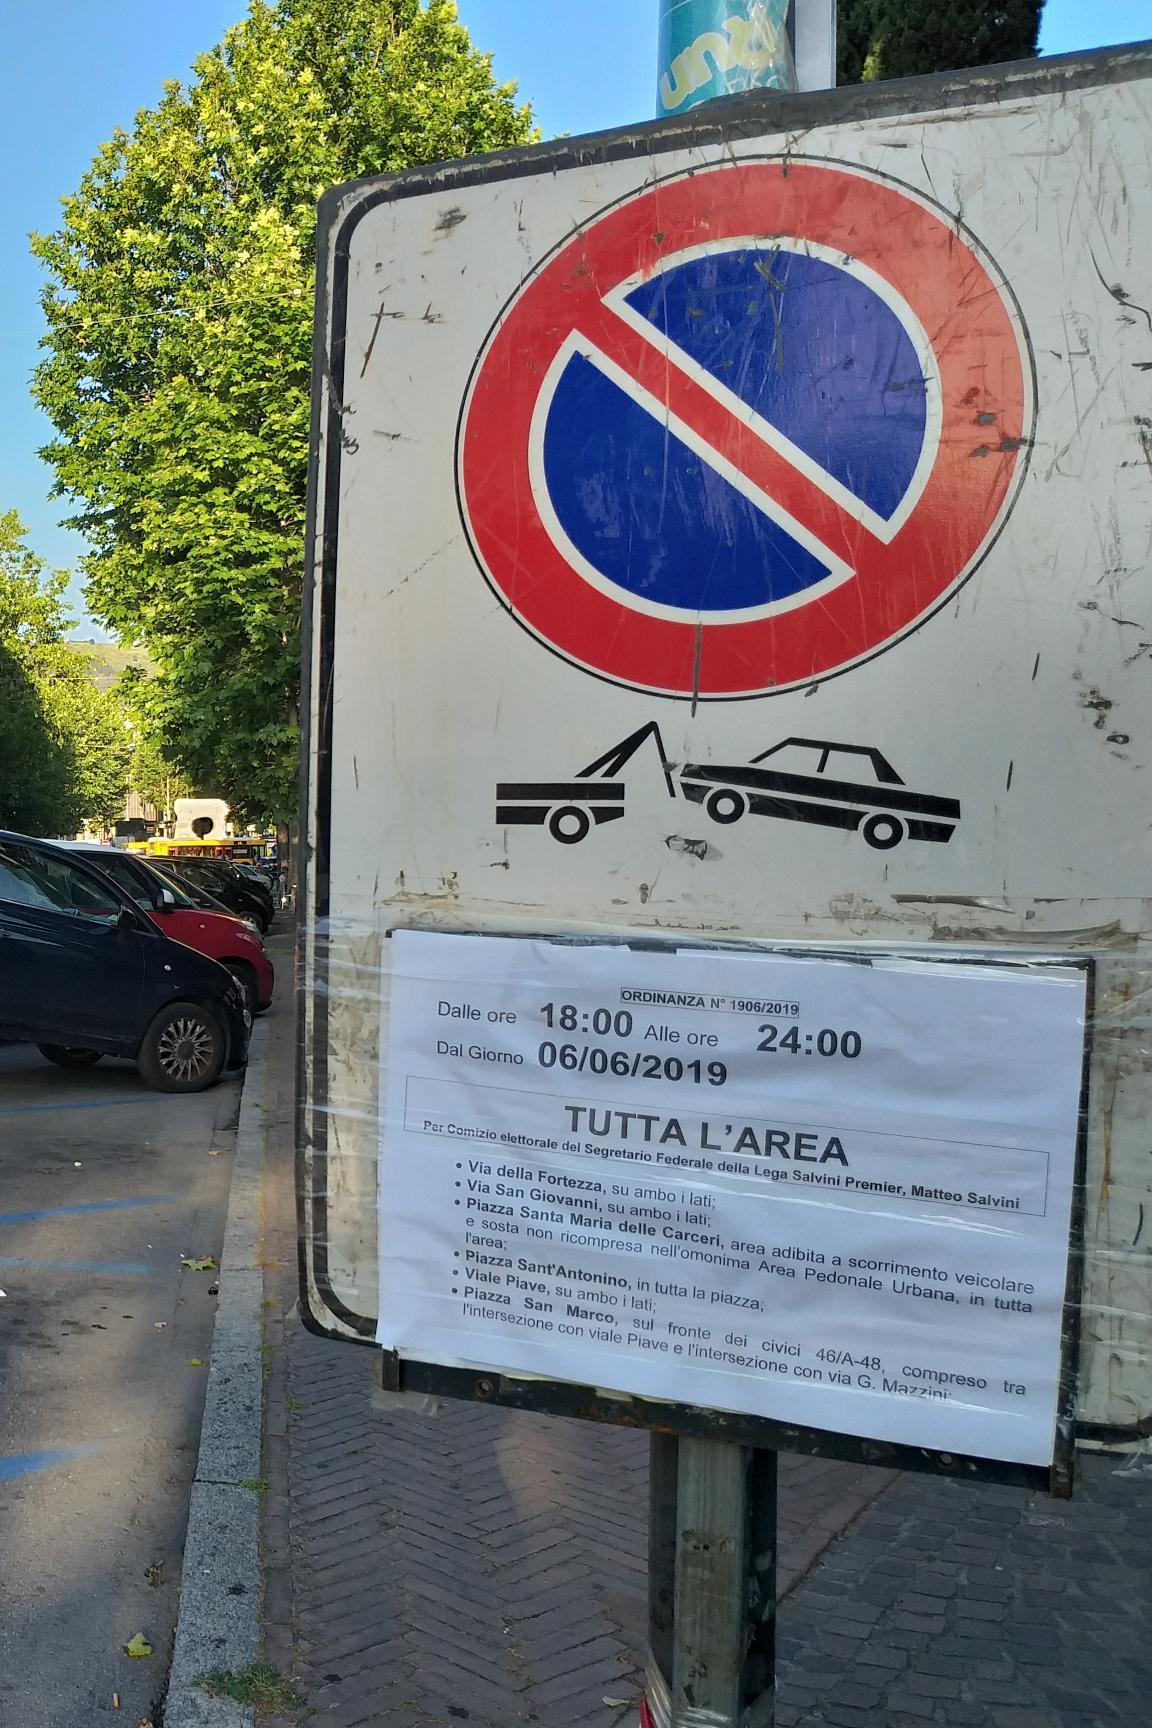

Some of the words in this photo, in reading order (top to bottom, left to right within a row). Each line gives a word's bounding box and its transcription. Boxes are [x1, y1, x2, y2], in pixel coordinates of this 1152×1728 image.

[622, 990, 705, 1007] ORDINANZA
[730, 1000, 798, 1015] 1906/2019
[438, 1001, 481, 1023] Dalle
[487, 1009, 517, 1024] ore
[539, 1002, 633, 1038] 18:00
[644, 1024, 680, 1044] Alle
[687, 1030, 719, 1047] ore
[757, 1024, 862, 1058] 24:00
[437, 1040, 463, 1058] Dal
[468, 1045, 524, 1065] Giorno
[538, 1041, 728, 1087] 06/06/2019
[563, 1105, 687, 1147] TUTTA
[423, 1120, 444, 1133] Per
[447, 1124, 497, 1140] Comizio
[500, 1132, 558, 1149] elettorale
[561, 1141, 581, 1153] del
[584, 1143, 652, 1161] Segretario
[656, 1153, 713, 1169] Federale
[718, 1161, 750, 1174] della
[755, 1165, 788, 1180] Lega
[792, 1169, 841, 1187] Salvini
[845, 1176, 907, 1196] Premier,
[911, 1184, 962, 1202] Matteo
[967, 1192, 1020, 1209] Salvini
[468, 1160, 492, 1175] Via
[497, 1165, 533, 1180] della
[538, 1171, 607, 1195] Fortezza,
[612, 1184, 629, 1196] su
[634, 1187, 676, 1202] ambo
[681, 1191, 685, 1204] i
[689, 1192, 716, 1210] lati;
[467, 1179, 490, 1194] Via
[495, 1183, 524, 1199] San
[530, 1188, 603, 1213] Giovanni,
[607, 1202, 625, 1214] su
[629, 1206, 672, 1221] ambo
[676, 1210, 680, 1222] i
[685, 1211, 711, 1228] lati;
[465, 1232, 507, 1250] l'area;
[465, 1217, 475, 1226] e
[481, 1219, 519, 1234] sosta
[526, 1227, 553, 1240] non
[561, 1230, 642, 1253] ricompresa
[650, 1243, 750, 1270] nell'omonima
[758, 1260, 796, 1278] Area
[805, 1267, 883, 1290] Pedonale
[893, 1280, 959, 1304] Urbana,
[970, 1292, 985, 1306] in
[994, 1296, 1033, 1313] tutta
[466, 1197, 514, 1216] Piazza
[520, 1206, 564, 1224] Santa
[570, 1213, 612, 1231] Maria
[618, 1220, 656, 1237] delle
[662, 1226, 725, 1249] Carceri,
[730, 1239, 765, 1255] area
[771, 1246, 825, 1264] adibita
[831, 1255, 842, 1266] a
[848, 1256, 948, 1282] scorrimento
[955, 1272, 1035, 1295] veicolare
[465, 1250, 513, 1268] Piazza
[518, 1258, 631, 1290] Sant'Antonino,
[637, 1278, 649, 1291] in
[655, 1281, 687, 1297] tutta
[693, 1286, 705, 1300] la
[710, 1291, 764, 1312] piazza;
[465, 1267, 500, 1284] Viale
[506, 1275, 550, 1295] Piave,
[555, 1286, 572, 1297] su
[577, 1289, 618, 1305] ambo
[623, 1295, 627, 1307] i
[631, 1295, 657, 1313] lati;
[463, 1303, 553, 1331] l'intersezione
[558, 1324, 584, 1336] con
[589, 1328, 622, 1343] viale
[627, 1333, 668, 1351] Piave
[673, 1344, 683, 1355] e
[688, 1344, 788, 1374] l'intersezione
[794, 1366, 822, 1380] con
[828, 1371, 851, 1385] via
[857, 1374, 876, 1390] G.
[464, 1286, 511, 1305] Piazza
[524, 1297, 553, 1312] San
[567, 1304, 618, 1326] Marco,
[632, 1318, 654, 1331] sul
[668, 1322, 711, 1340] fronte
[725, 1332, 747, 1347] dei
[762, 1340, 801, 1357] civici
[815, 1348, 885, 1375] 46/A-48,
[902, 1365, 987, 1389] compreso
[1003, 1380, 1026, 1395] tra
